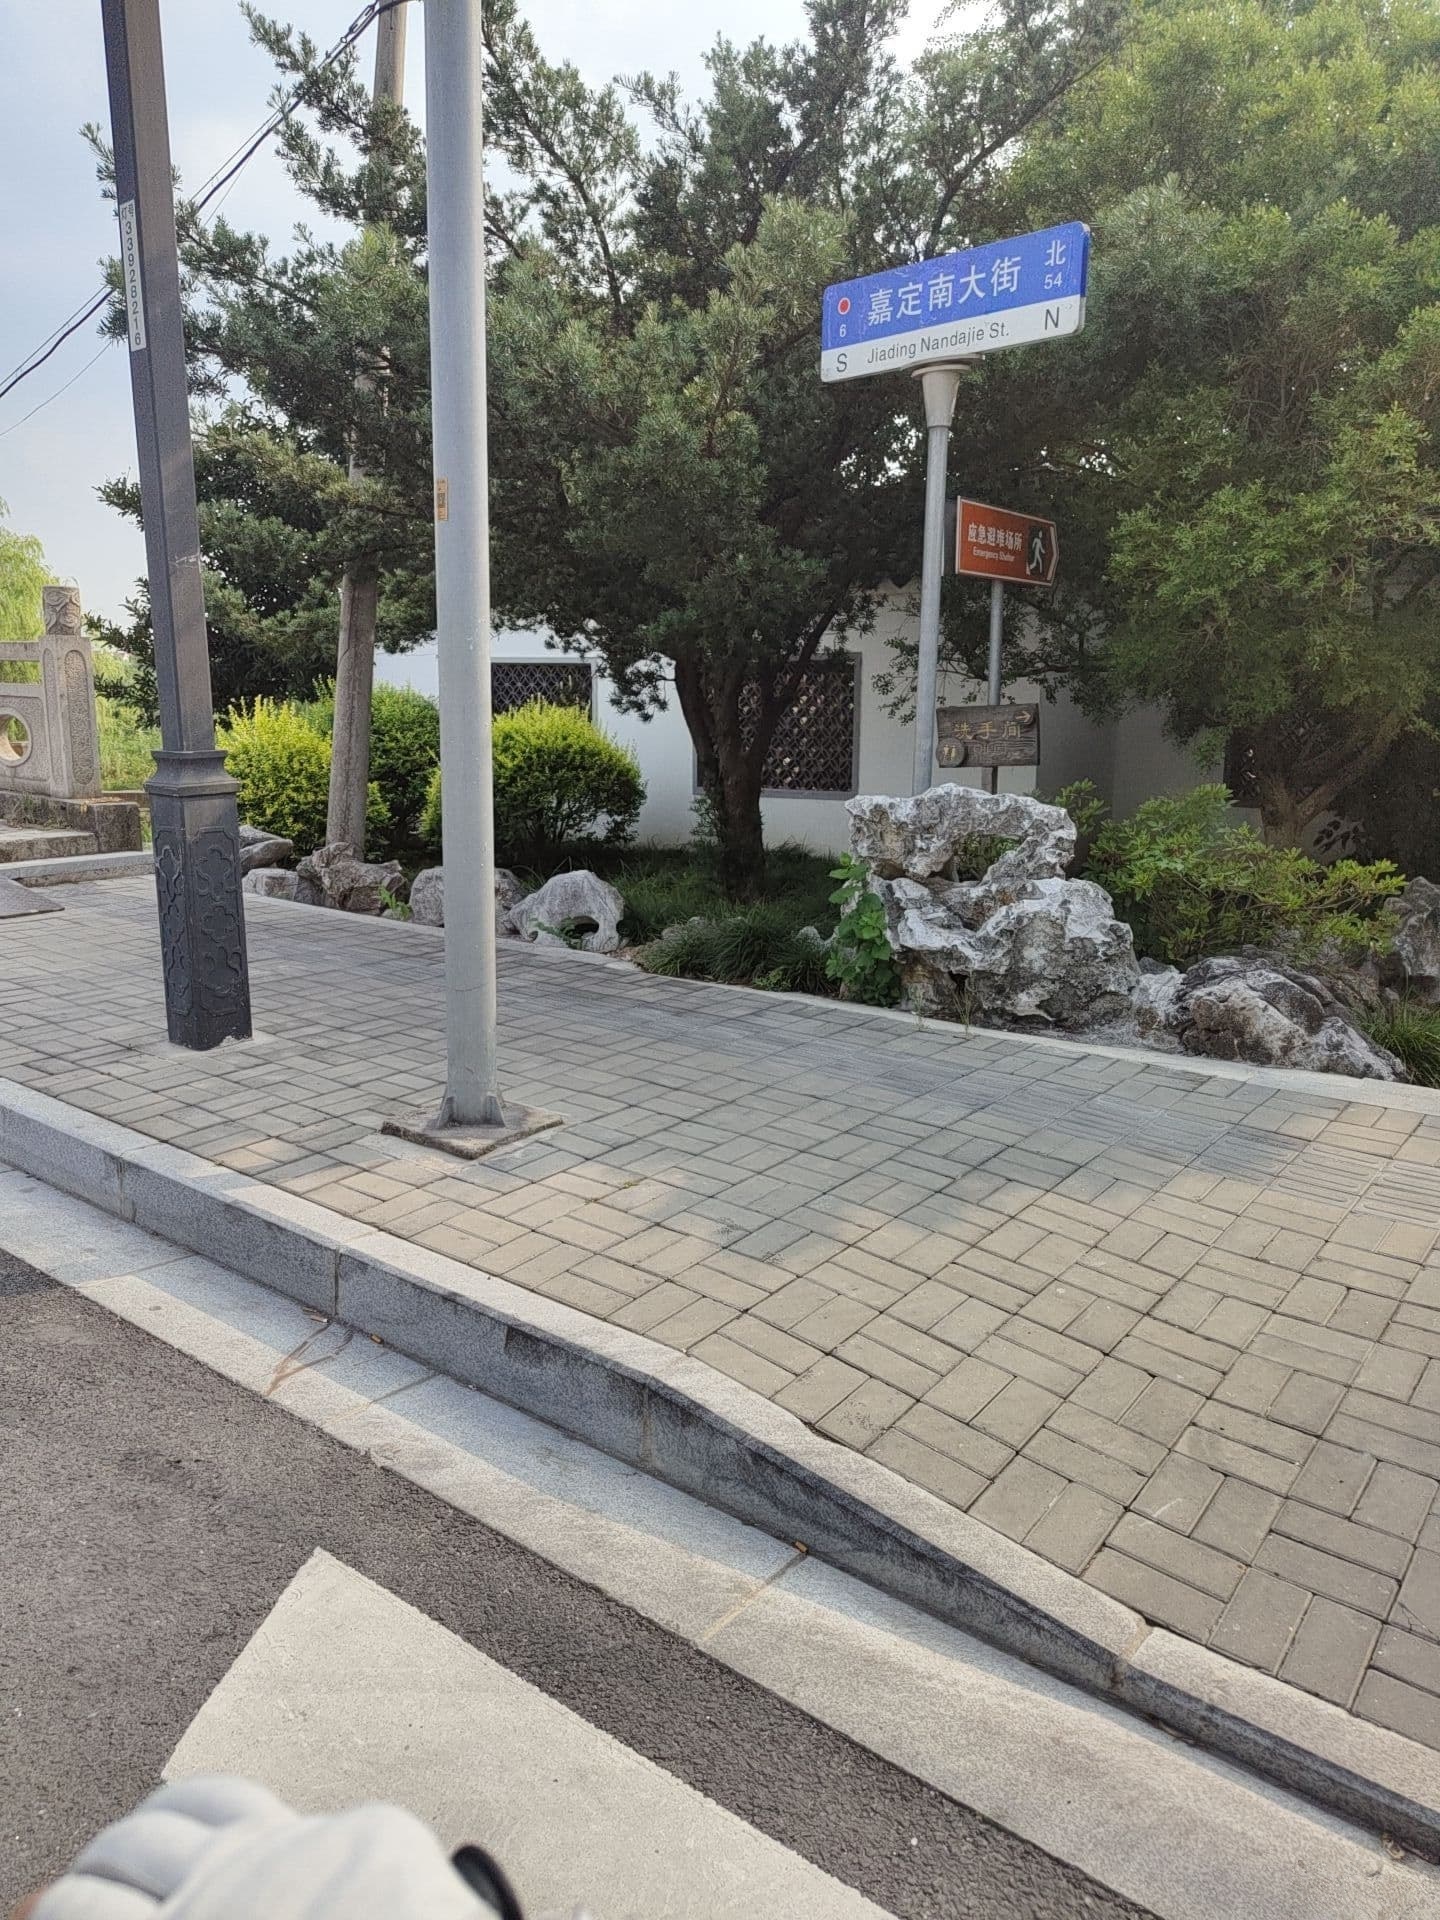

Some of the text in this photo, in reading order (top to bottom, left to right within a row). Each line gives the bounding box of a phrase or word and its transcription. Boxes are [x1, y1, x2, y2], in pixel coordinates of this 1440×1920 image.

[1044, 240, 1067, 266] 北
[125, 221, 142, 346] 33928216
[868, 256, 1022, 327] 嘉定南大街
[1044, 276, 1063, 290] 54
[839, 324, 847, 338] 6
[1044, 306, 1061, 331] N
[867, 322, 1010, 364] Jiading Nandajie St.
[836, 353, 848, 374] S
[968, 522, 1023, 551] 应急避难场所
[954, 721, 1021, 740] 洗手间
